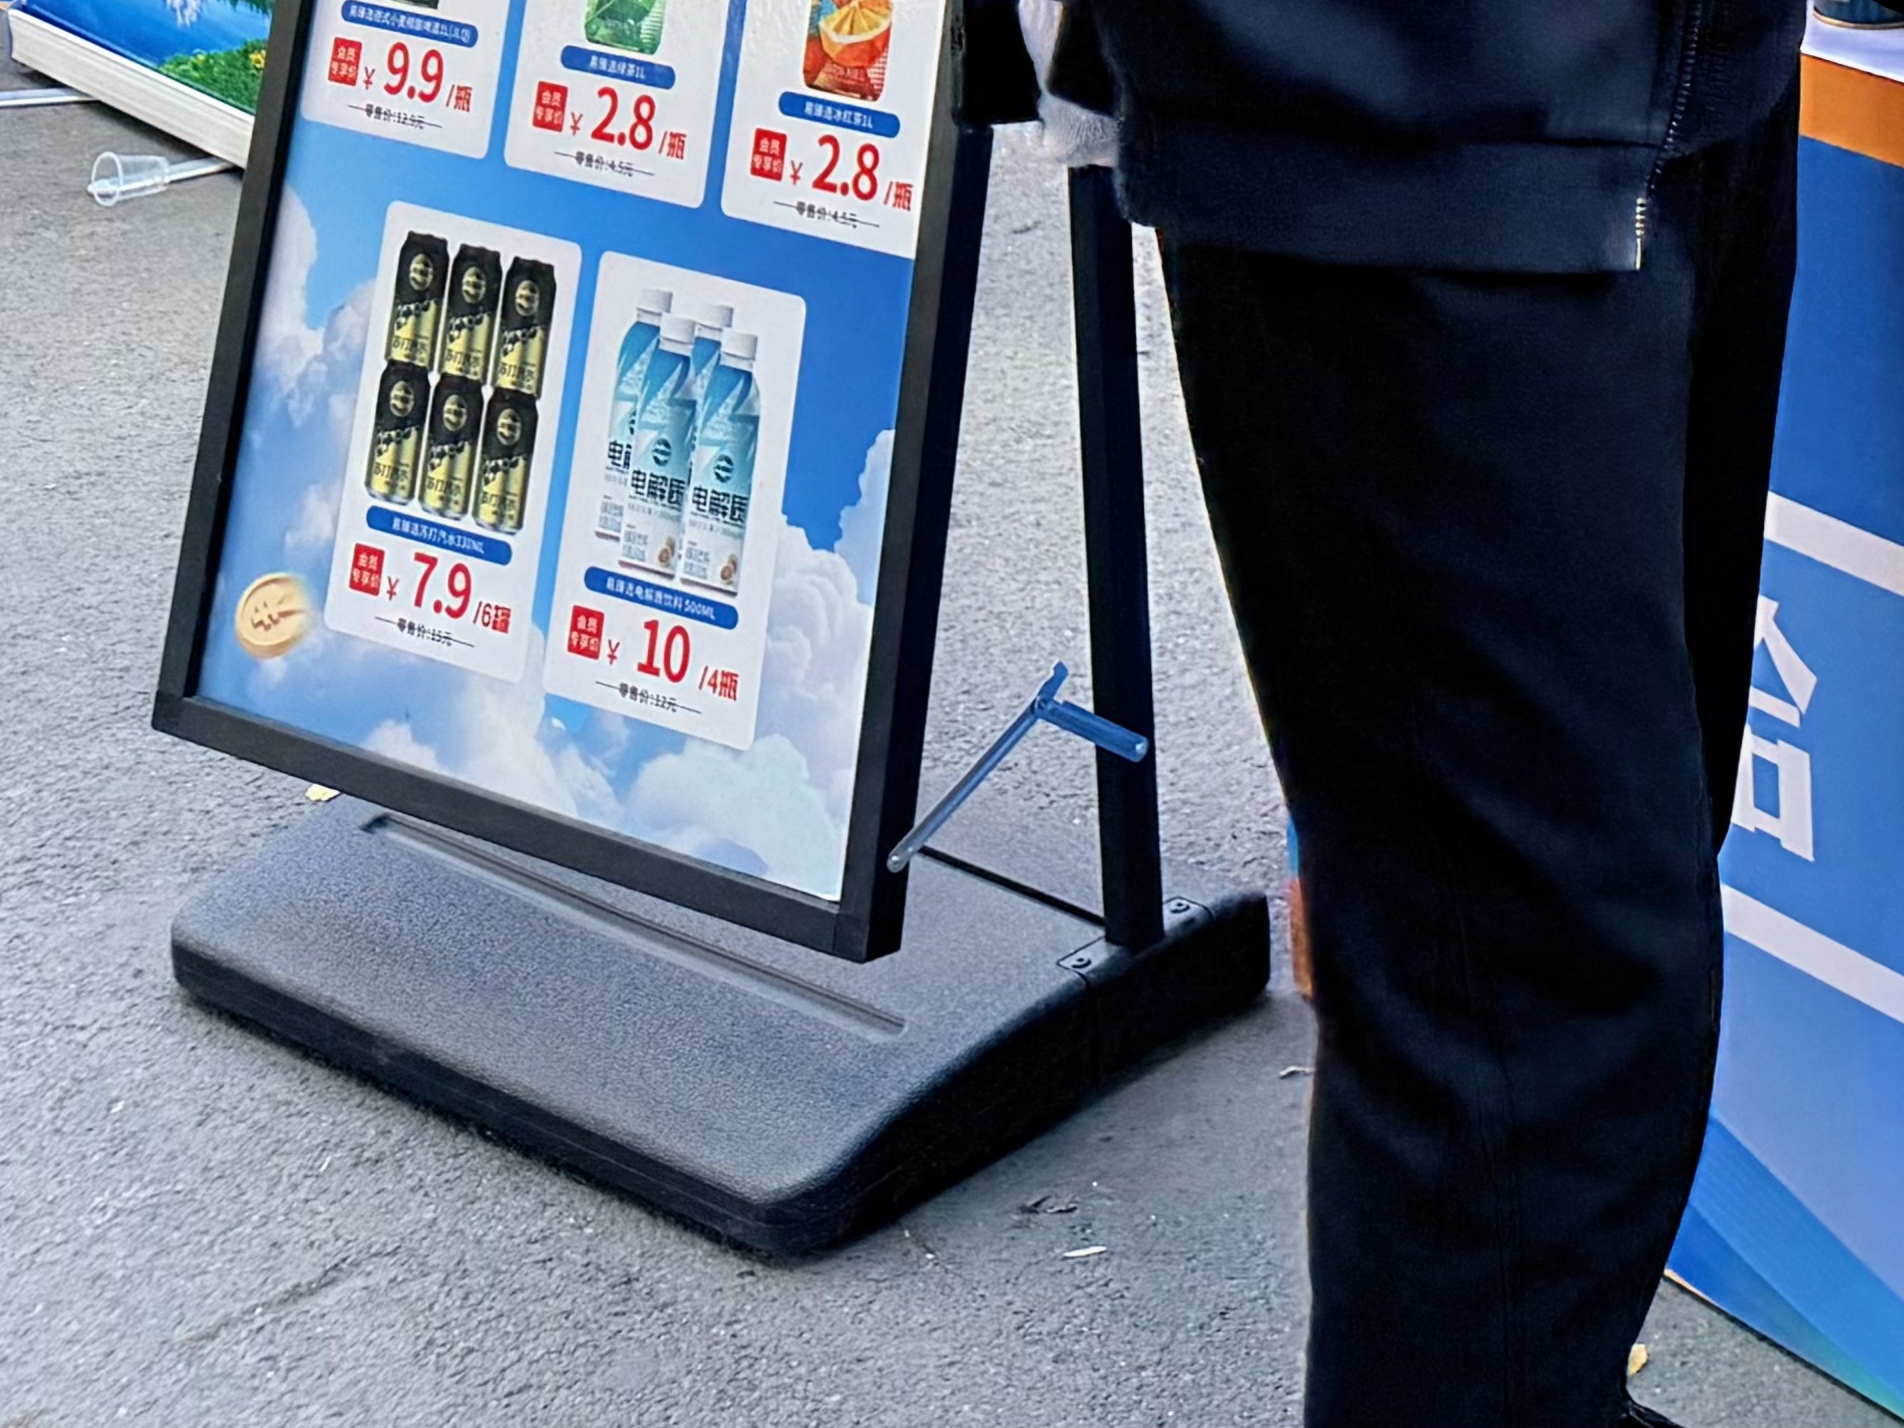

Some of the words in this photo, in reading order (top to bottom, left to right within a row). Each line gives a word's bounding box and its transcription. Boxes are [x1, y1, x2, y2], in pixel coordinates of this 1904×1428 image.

[384, 42, 443, 104] 9.9
[591, 86, 656, 151] 2.8
[812, 133, 880, 202] 2.8
[413, 552, 472, 620] 7.9
[637, 619, 690, 683] 10
